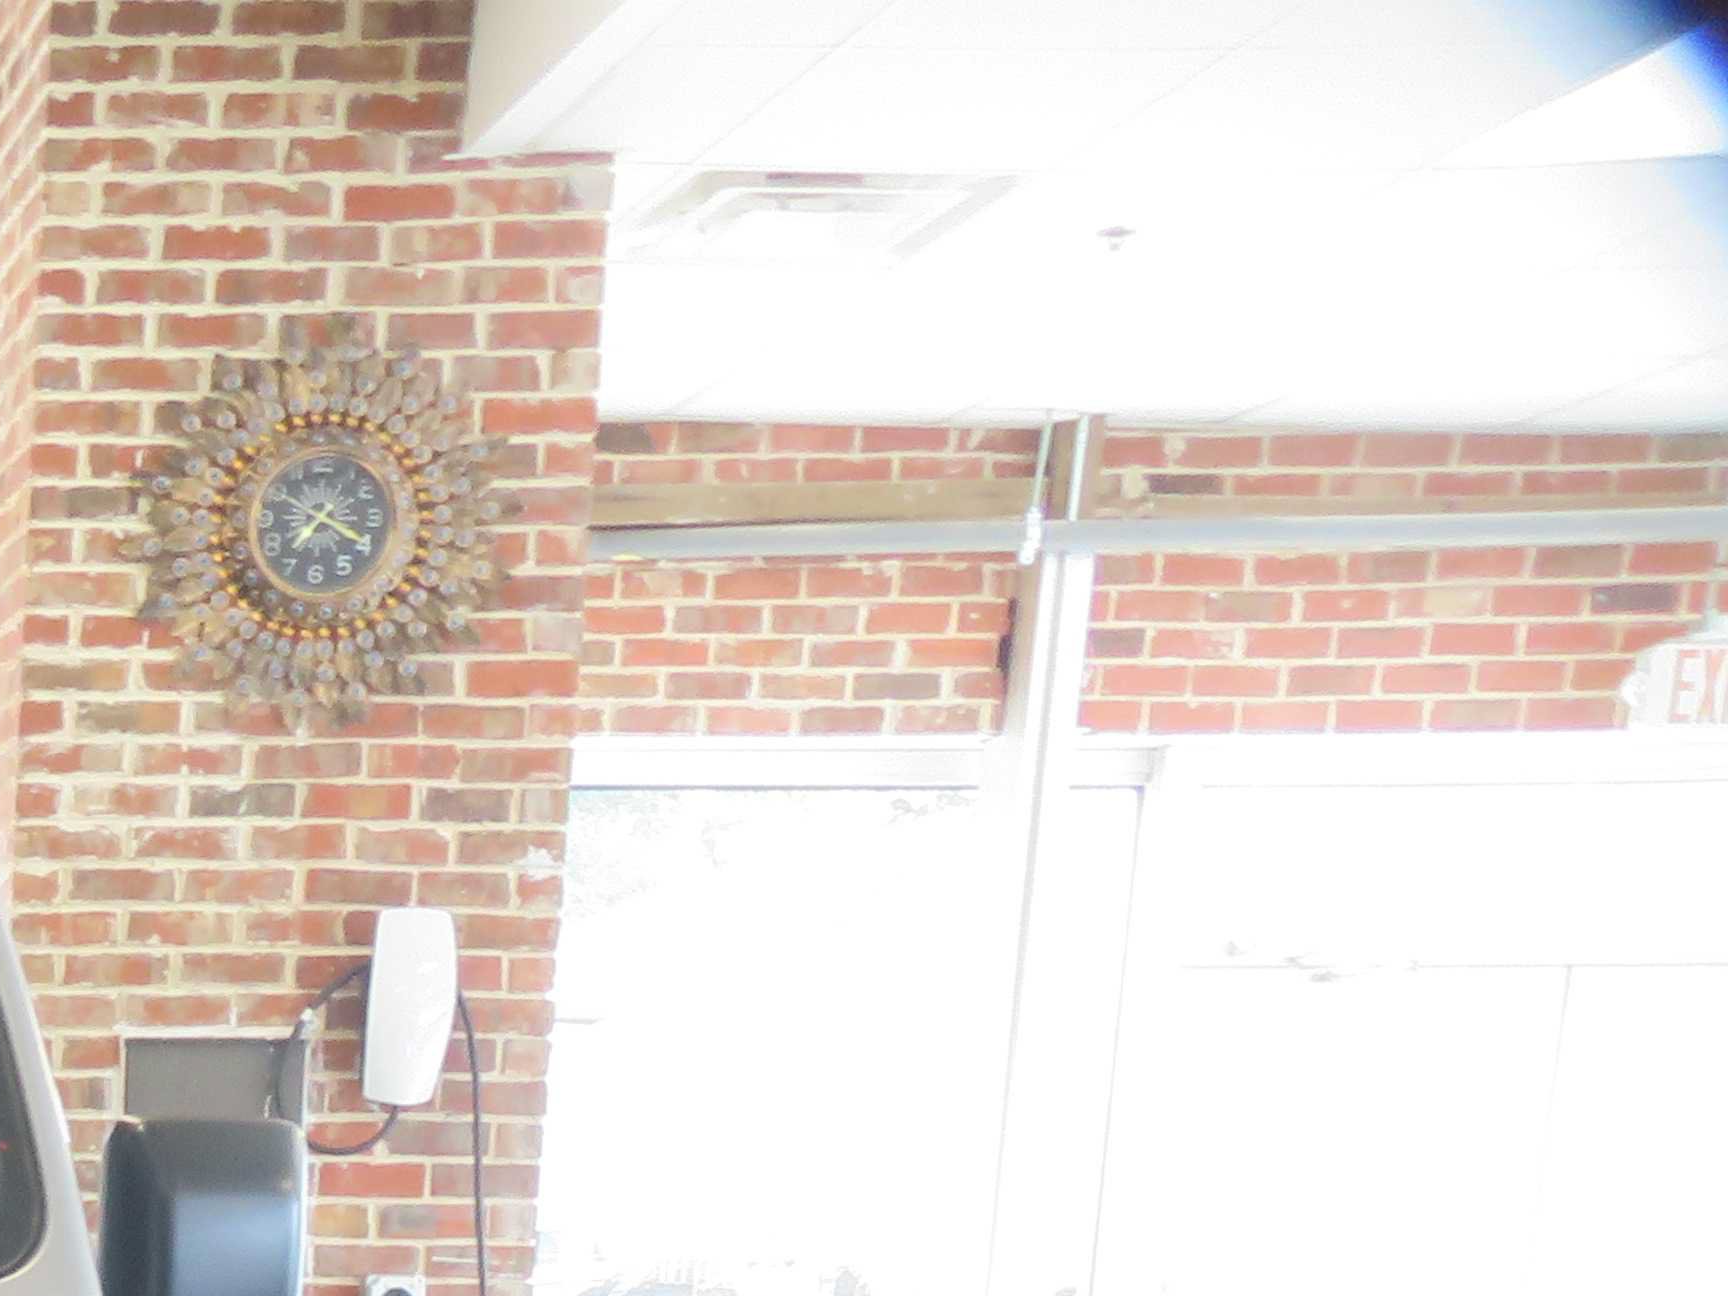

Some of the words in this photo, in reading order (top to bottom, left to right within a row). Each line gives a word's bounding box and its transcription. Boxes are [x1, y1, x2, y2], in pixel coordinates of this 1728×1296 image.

[367, 508, 384, 528] 3
[264, 532, 281, 556] 8
[355, 533, 372, 556] 4
[281, 558, 298, 577] 7
[307, 564, 325, 584] 6
[335, 554, 353, 576] 5
